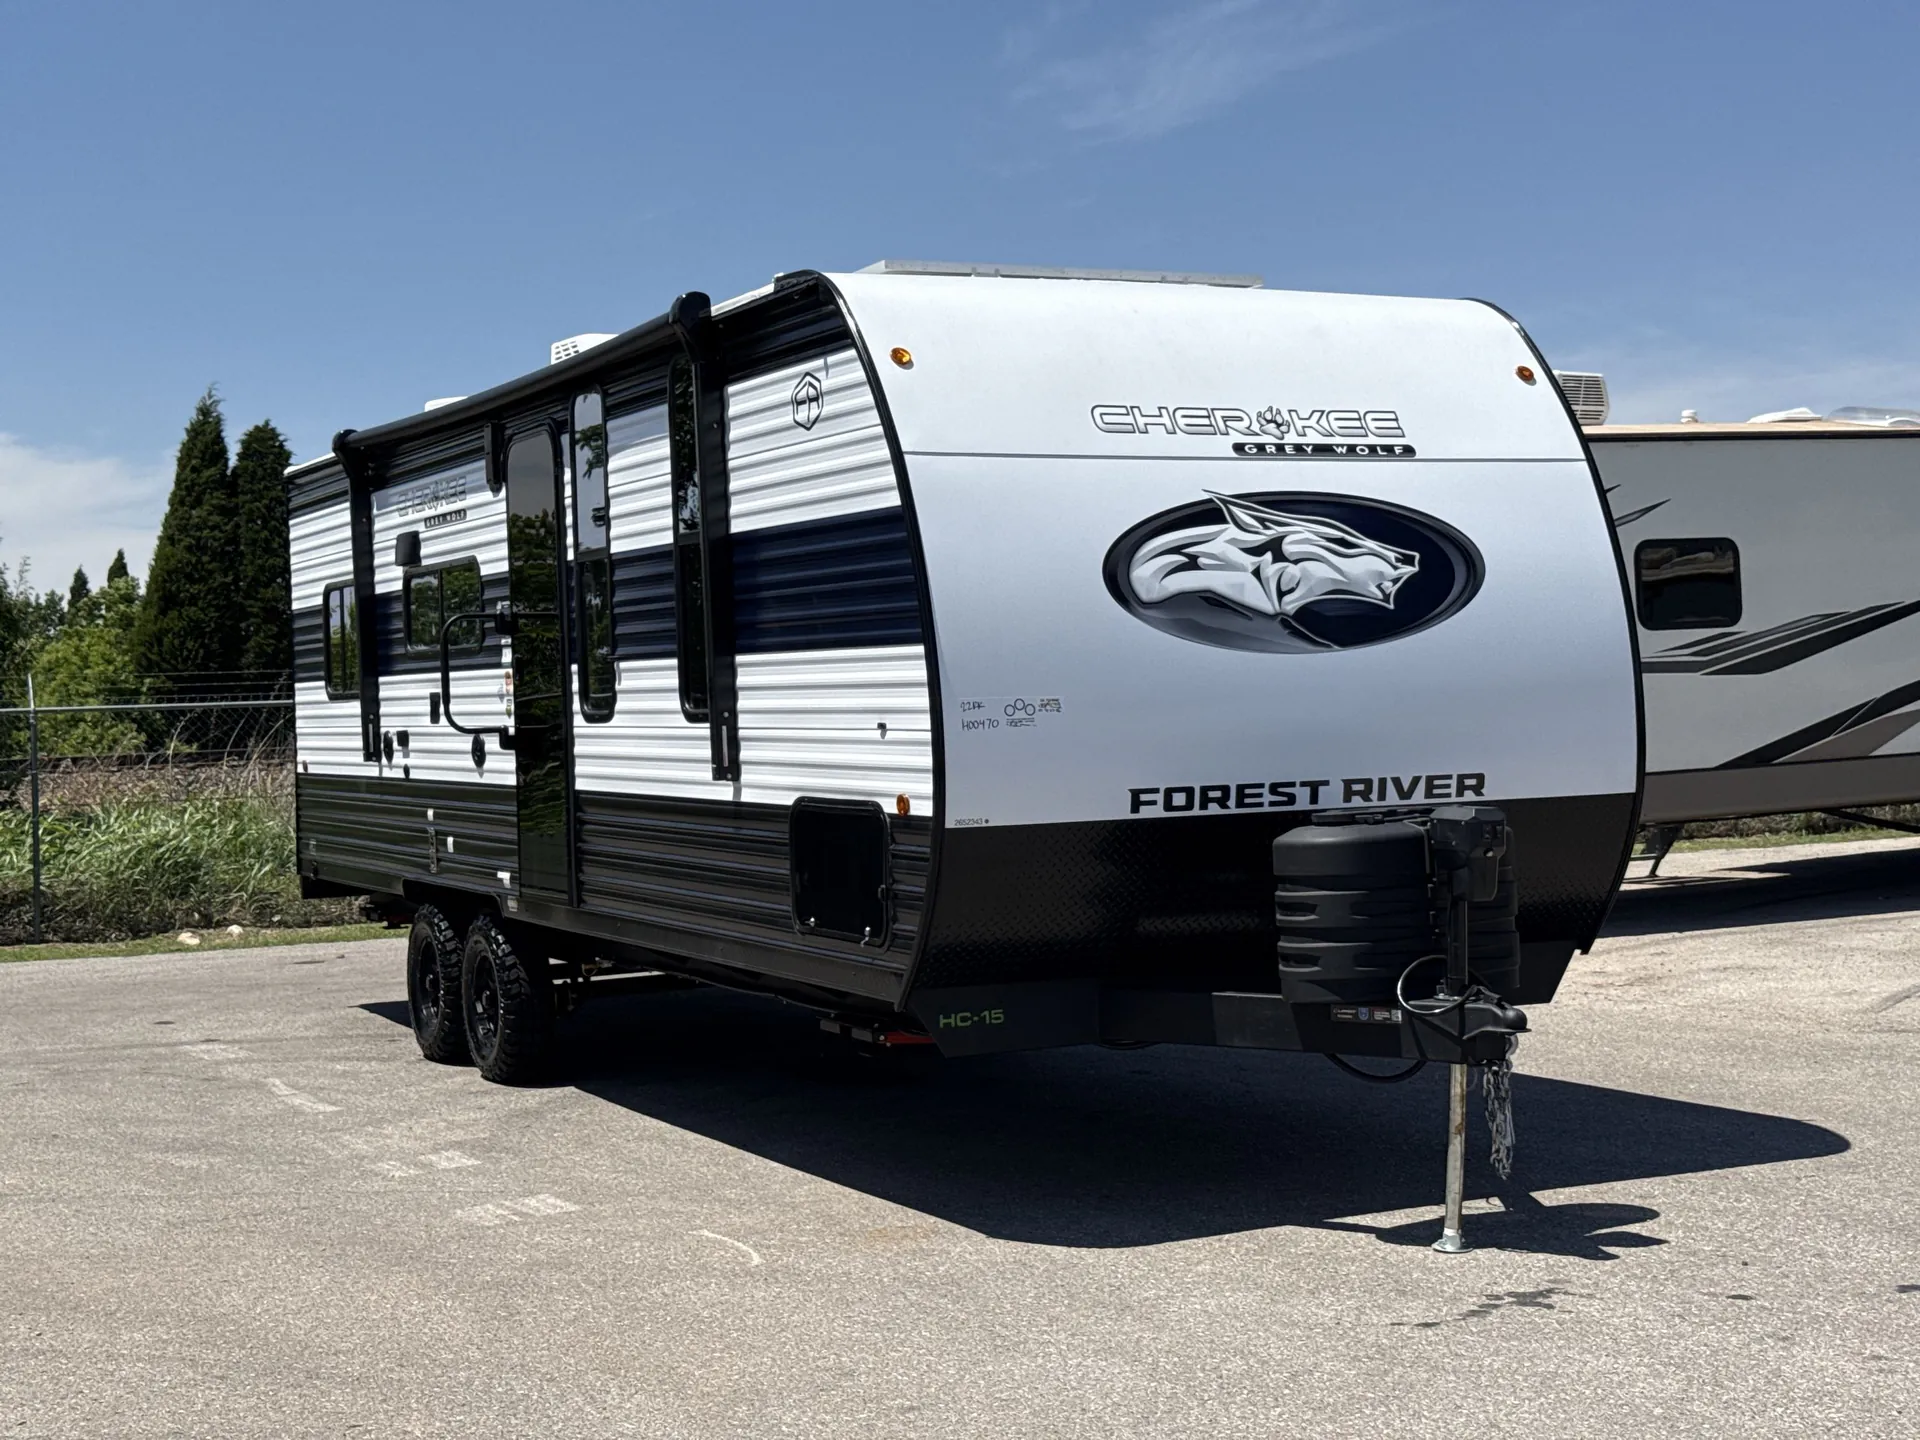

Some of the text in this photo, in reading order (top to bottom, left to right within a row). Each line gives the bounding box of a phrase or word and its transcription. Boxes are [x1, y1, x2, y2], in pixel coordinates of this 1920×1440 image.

[1244, 444, 1404, 456] GREY WOLF
[446, 510, 465, 521] WOLF
[1128, 772, 1486, 814] FOREST RIVER
[939, 1009, 1005, 1029] HC-15
